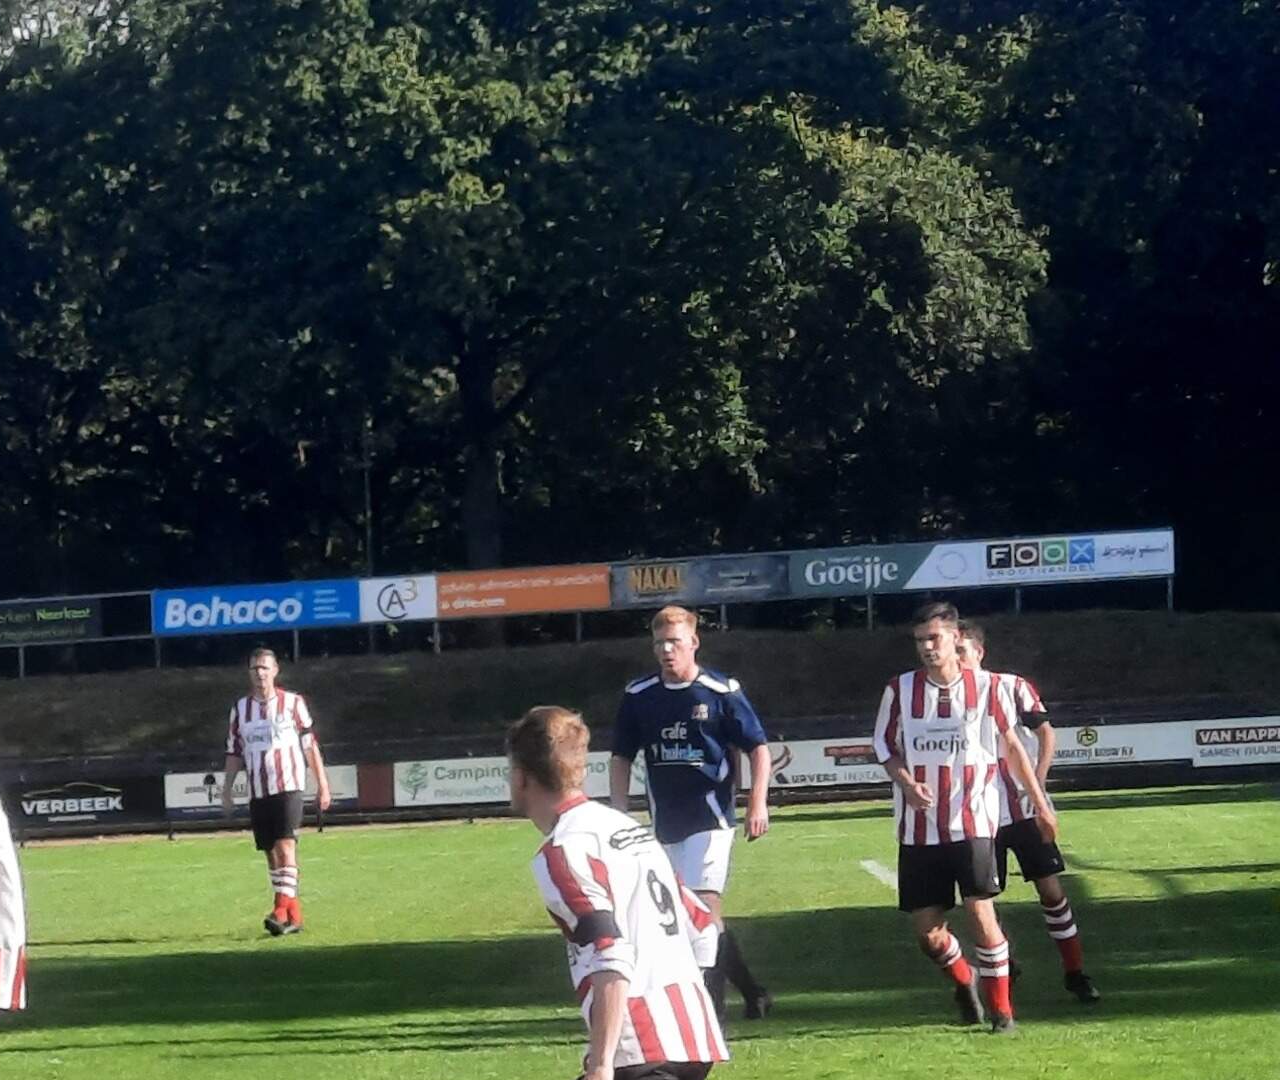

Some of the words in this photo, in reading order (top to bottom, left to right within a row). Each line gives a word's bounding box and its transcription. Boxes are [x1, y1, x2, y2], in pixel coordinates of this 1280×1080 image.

[164, 595, 303, 629] Bohaco
[660, 721, 688, 740] café
[1199, 730, 1231, 743] VAN
[20, 795, 124, 816] VERBEEK
[646, 868, 680, 936] 9
